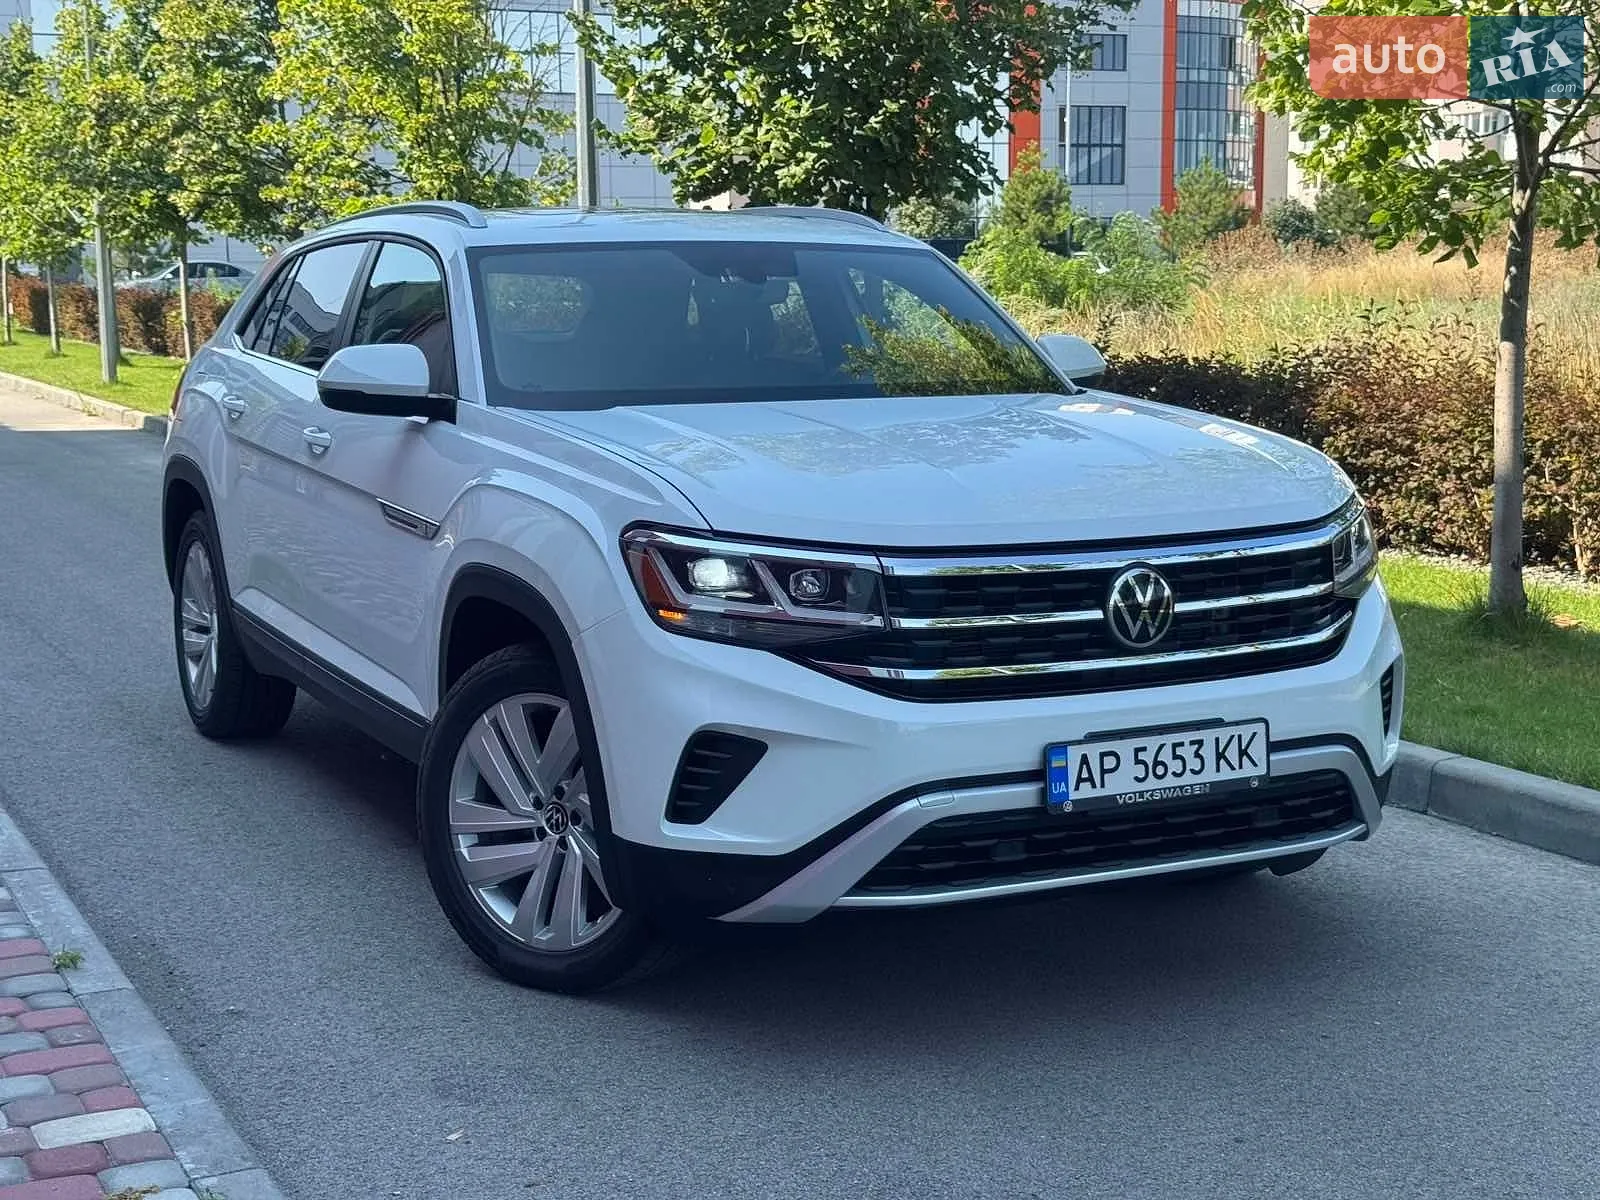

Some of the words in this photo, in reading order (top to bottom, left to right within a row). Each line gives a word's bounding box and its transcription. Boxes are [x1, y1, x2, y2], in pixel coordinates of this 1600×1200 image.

[1074, 749, 1121, 792] AP
[1133, 738, 1206, 783] 5653
[1214, 731, 1258, 773] KK
[1052, 782, 1067, 794] UA
[1116, 783, 1211, 805] VOLKSWAGEN
